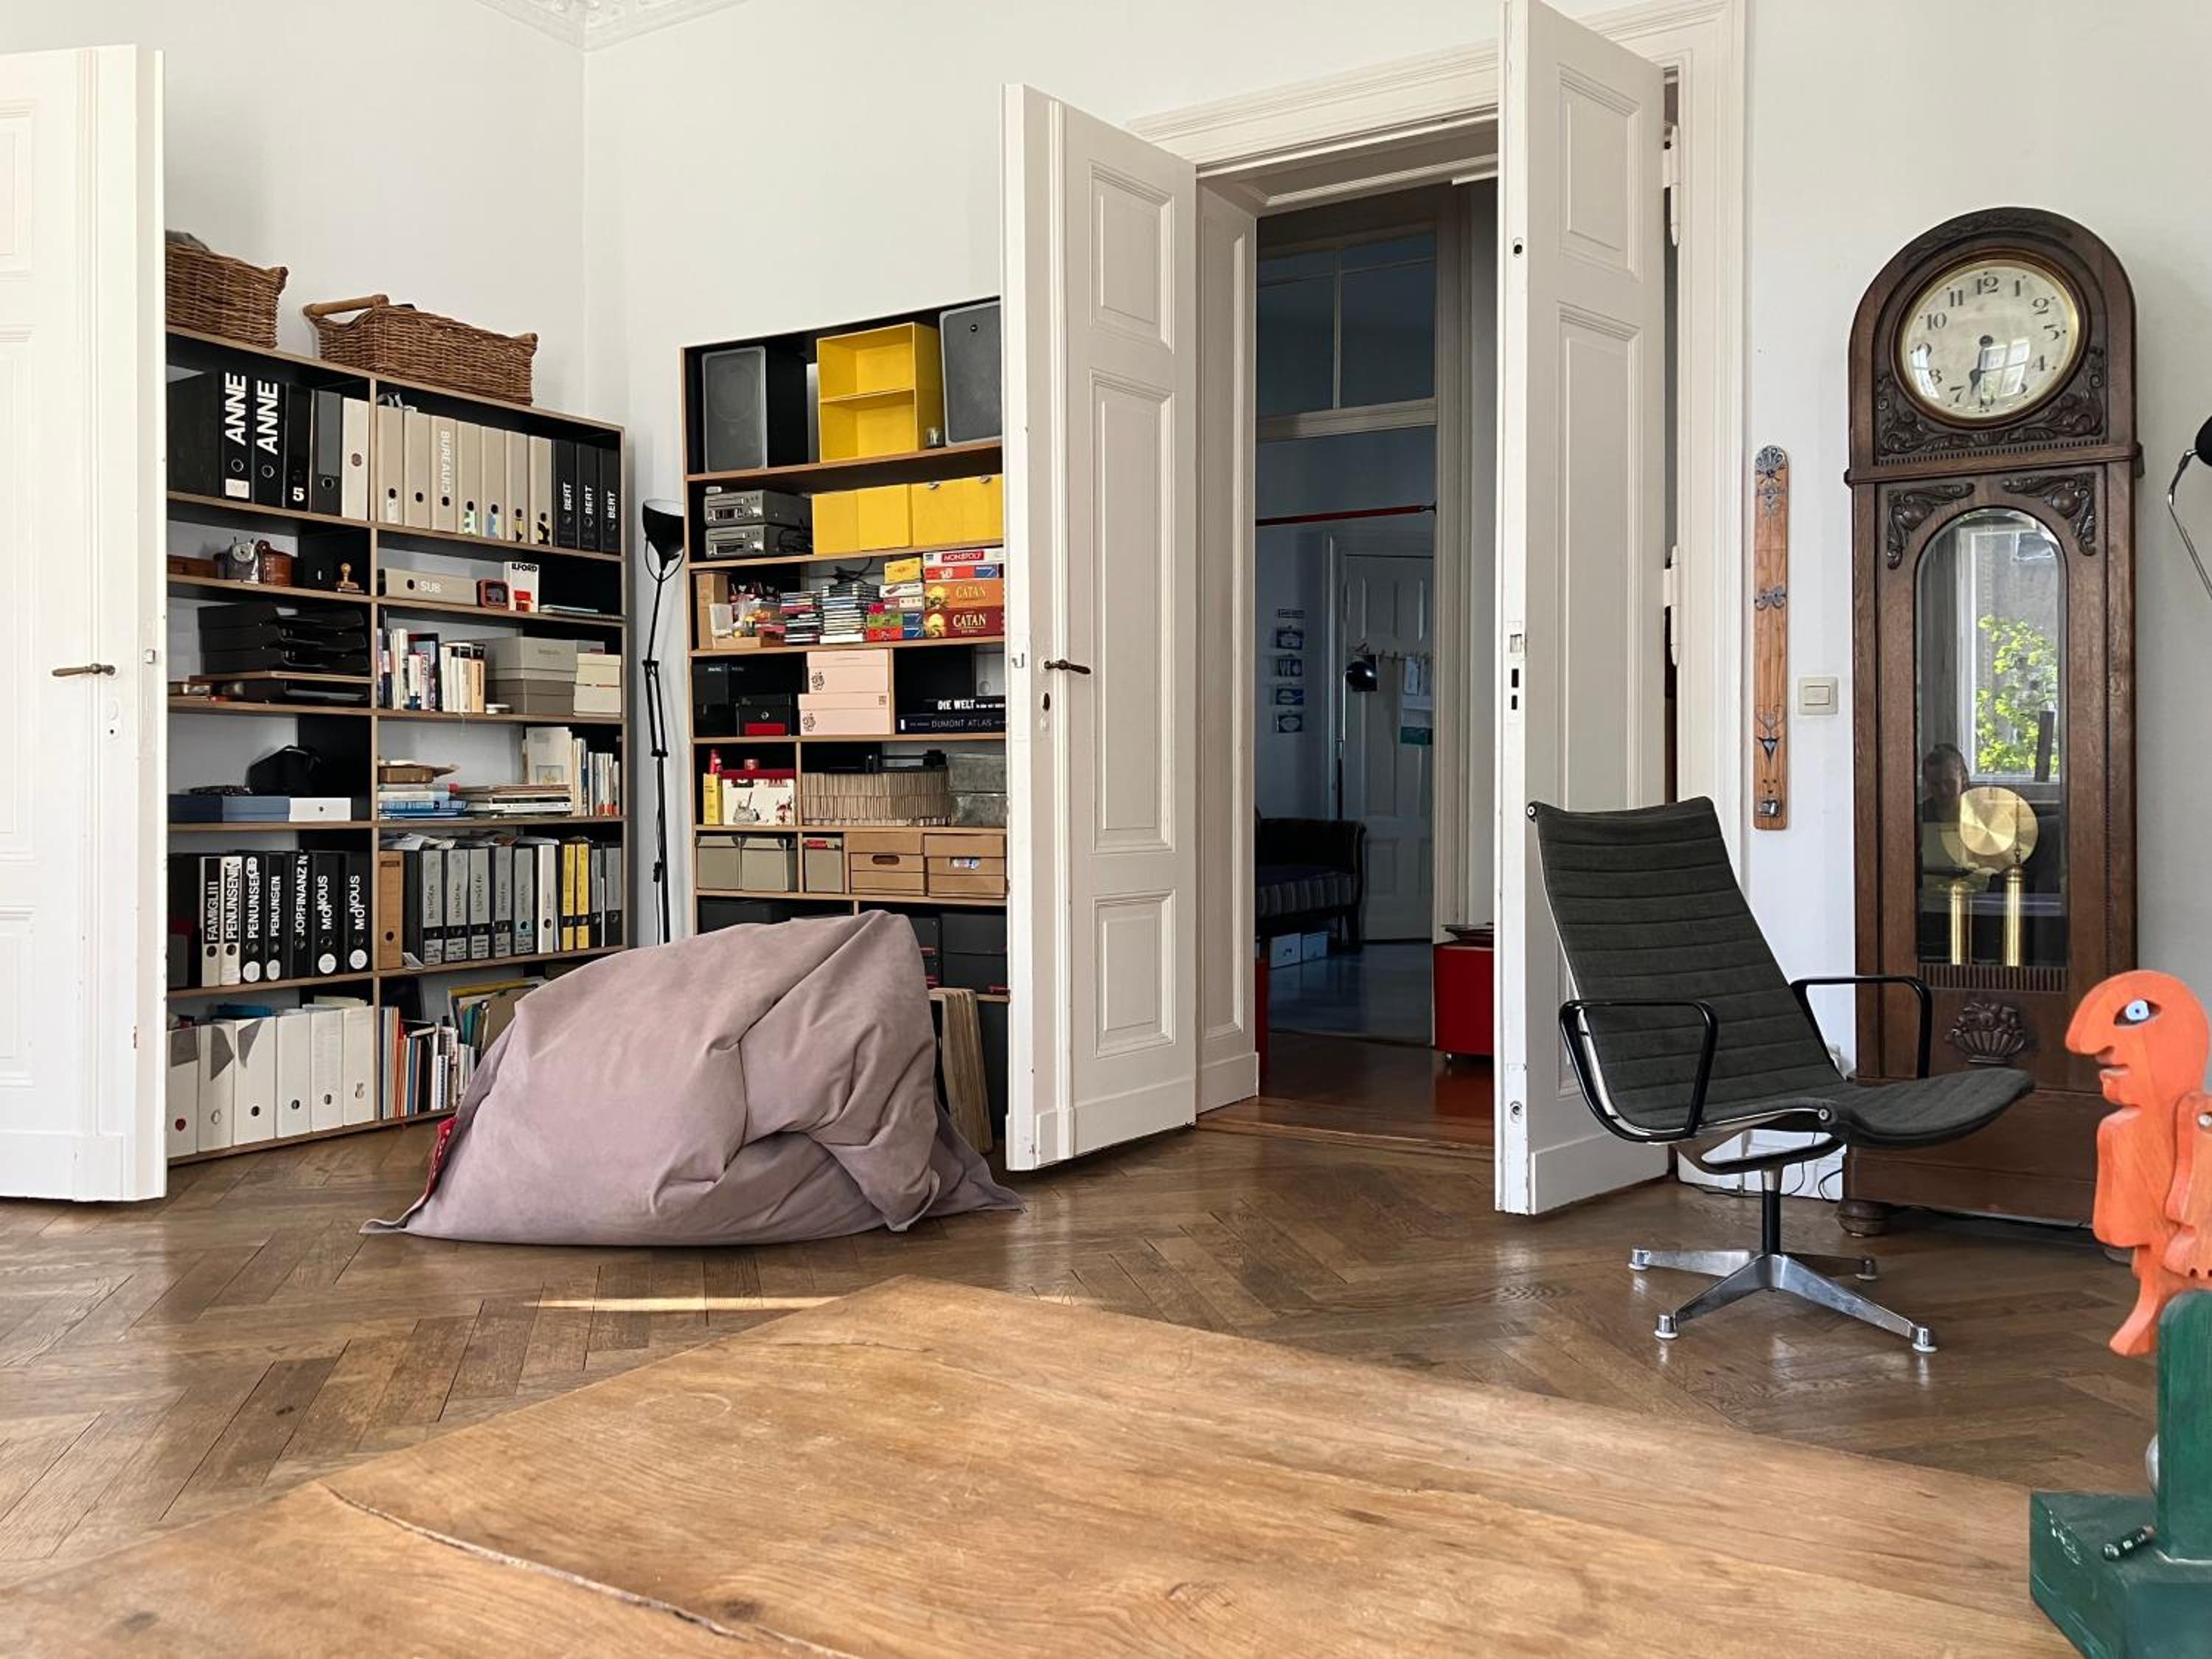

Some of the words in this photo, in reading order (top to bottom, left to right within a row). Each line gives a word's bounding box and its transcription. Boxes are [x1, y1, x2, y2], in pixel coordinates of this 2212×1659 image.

[1977, 276, 1998, 294] 12
[2014, 280, 2021, 296] 1
[1950, 290, 1964, 307] 11
[2032, 297, 2049, 315] 2
[1927, 312, 1947, 330] 10
[2032, 355, 2047, 372] 4
[1950, 386, 1964, 403] 7
[225, 372, 247, 446] ANNE
[257, 380, 278, 456] ANNE
[293, 487, 305, 502] 5
[956, 585, 986, 598] CATAN
[953, 613, 986, 627] CATAN
[937, 700, 952, 710] DIE
[953, 699, 975, 710] WELT
[931, 719, 964, 728] DUMONT
[968, 719, 992, 727] ATLAS
[349, 875, 361, 913] NOUS
[270, 875, 281, 937] PENUNSEN
